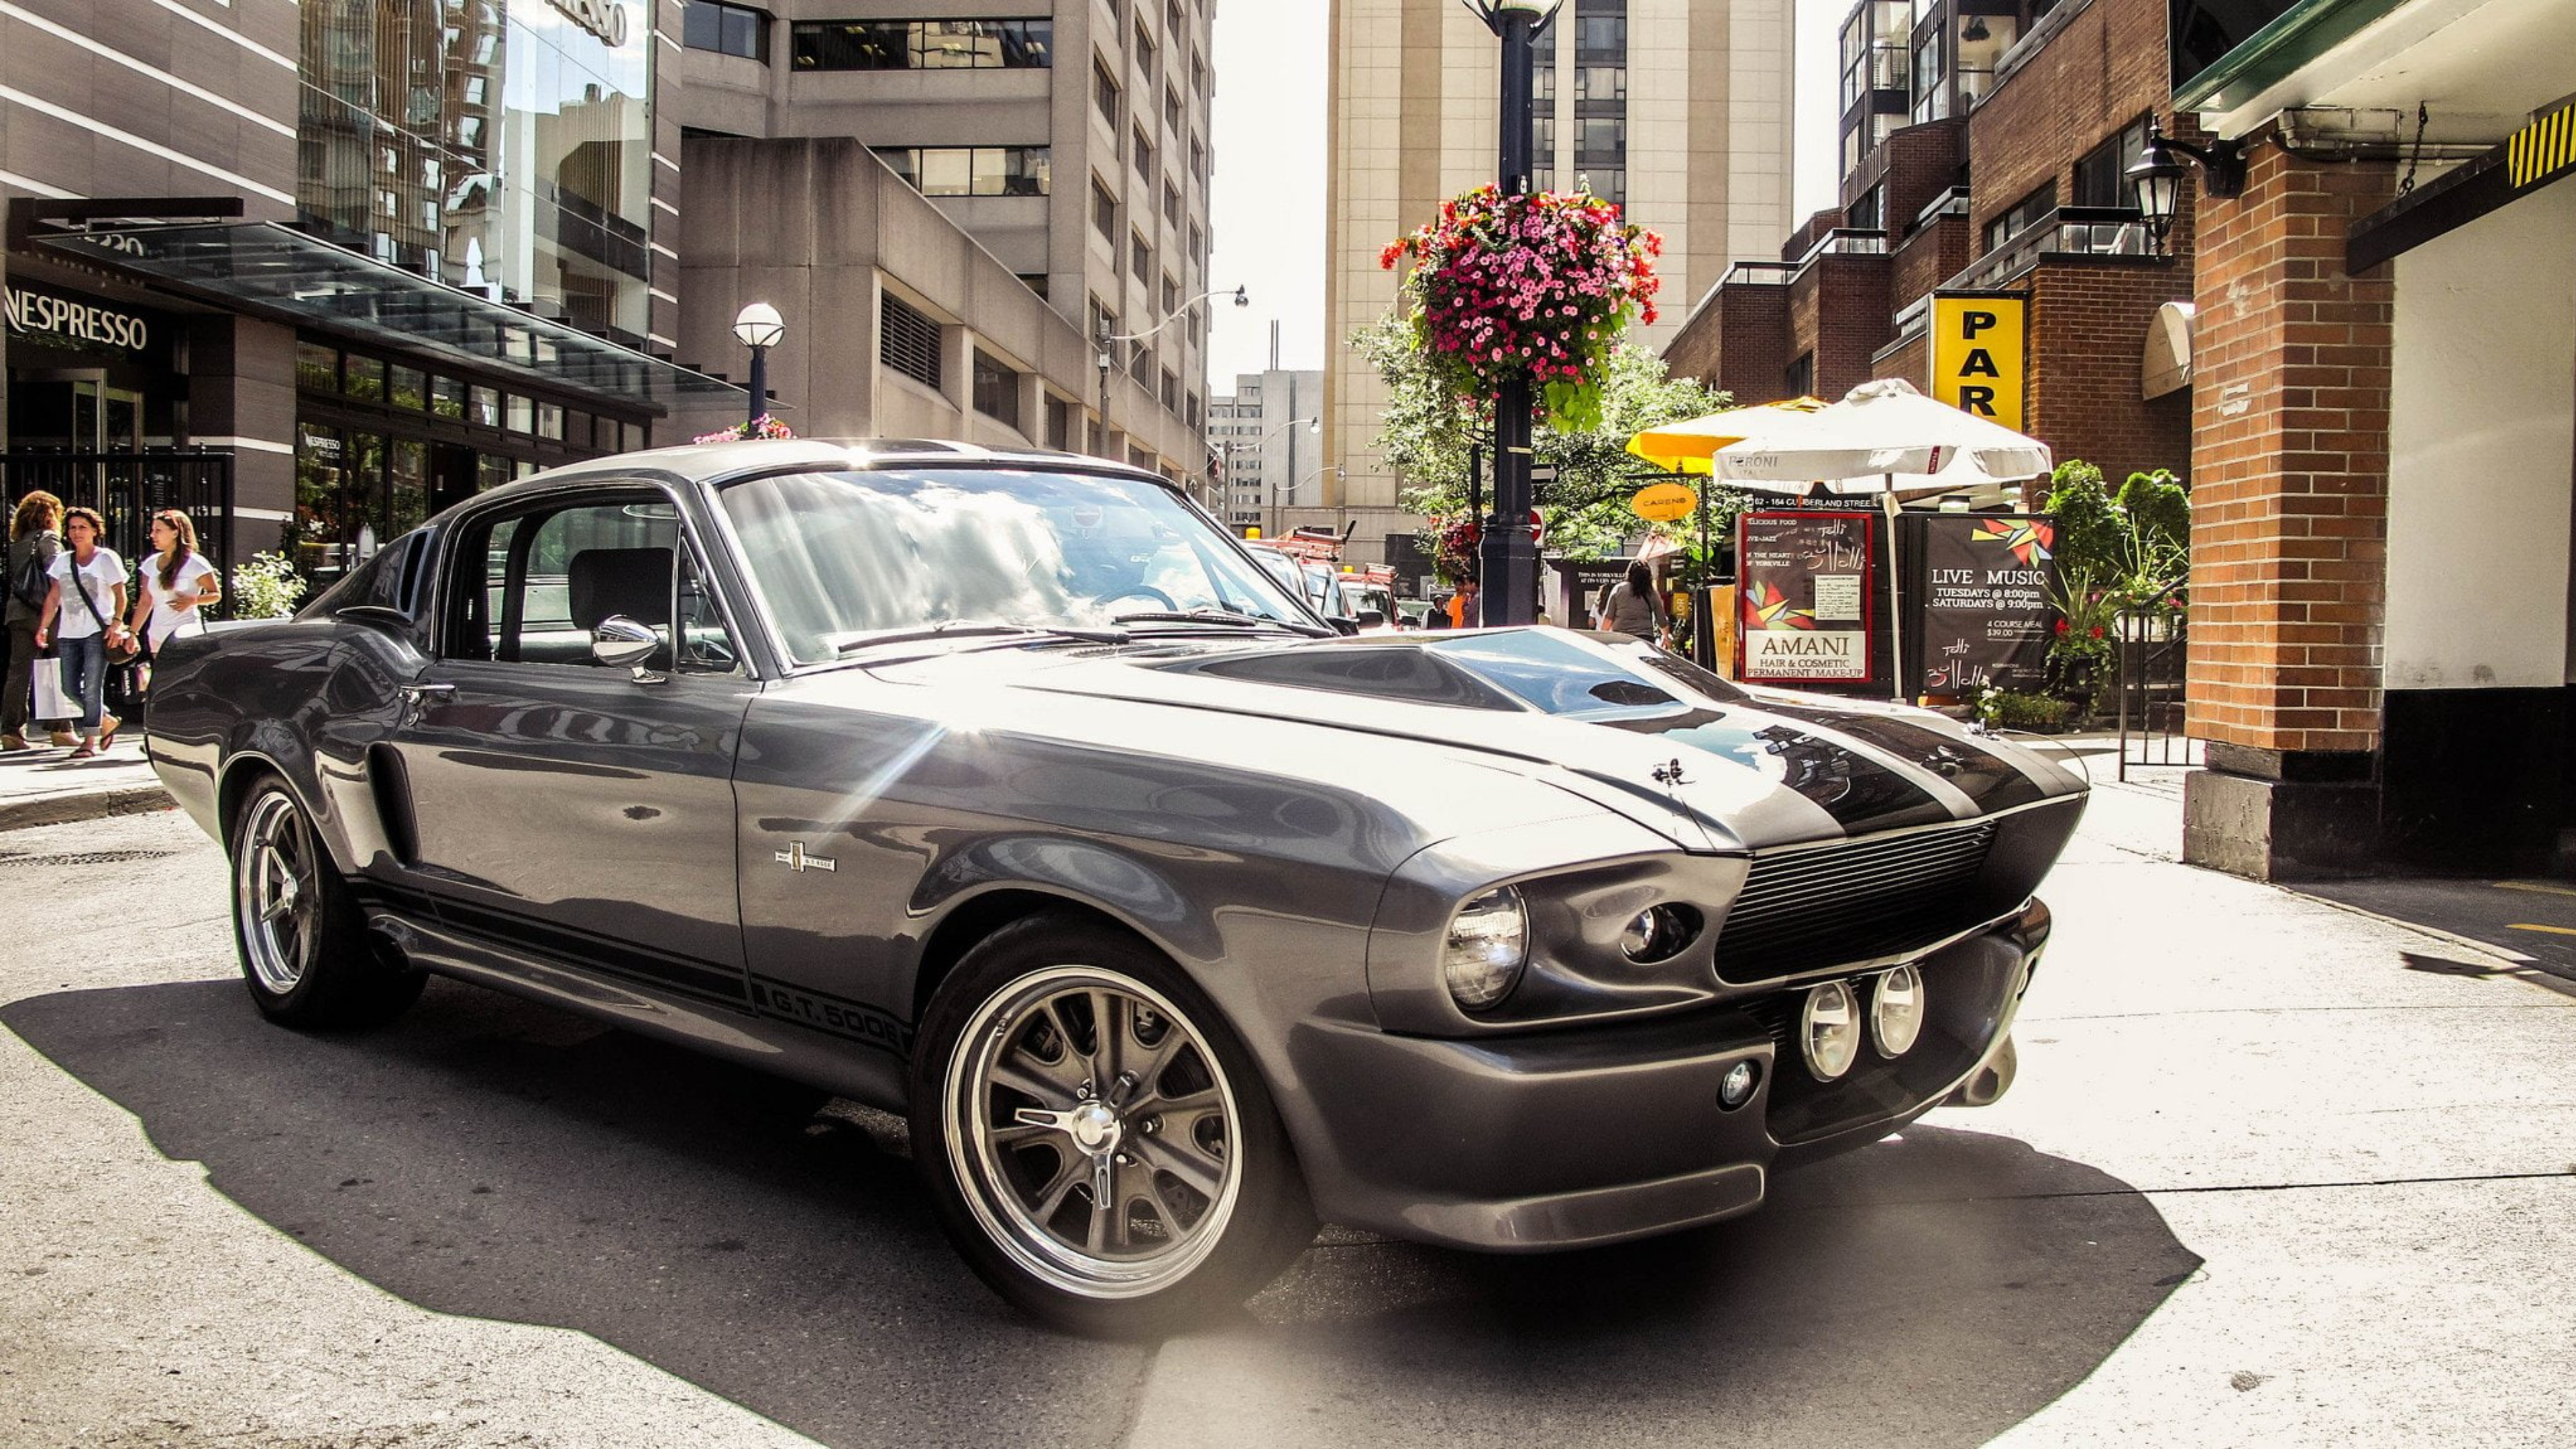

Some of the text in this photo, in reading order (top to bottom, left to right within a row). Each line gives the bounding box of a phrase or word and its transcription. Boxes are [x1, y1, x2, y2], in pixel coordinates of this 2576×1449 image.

[5, 285, 147, 350] NESPRESSO
[1786, 498, 1843, 507] CUBERLAND
[1844, 499, 1872, 507] STREE
[1931, 569, 2045, 585] LIVE MUSIC
[1936, 588, 2040, 602] TUESDAYS @ 8:00pm
[1932, 598, 2043, 610] SATURDAYS @ 9:00pm
[1761, 637, 1850, 655] AMANI
[1760, 659, 1850, 668] HAIR & COSMETIC
[1747, 668, 1863, 677] PERMANENT MAKE-UP
